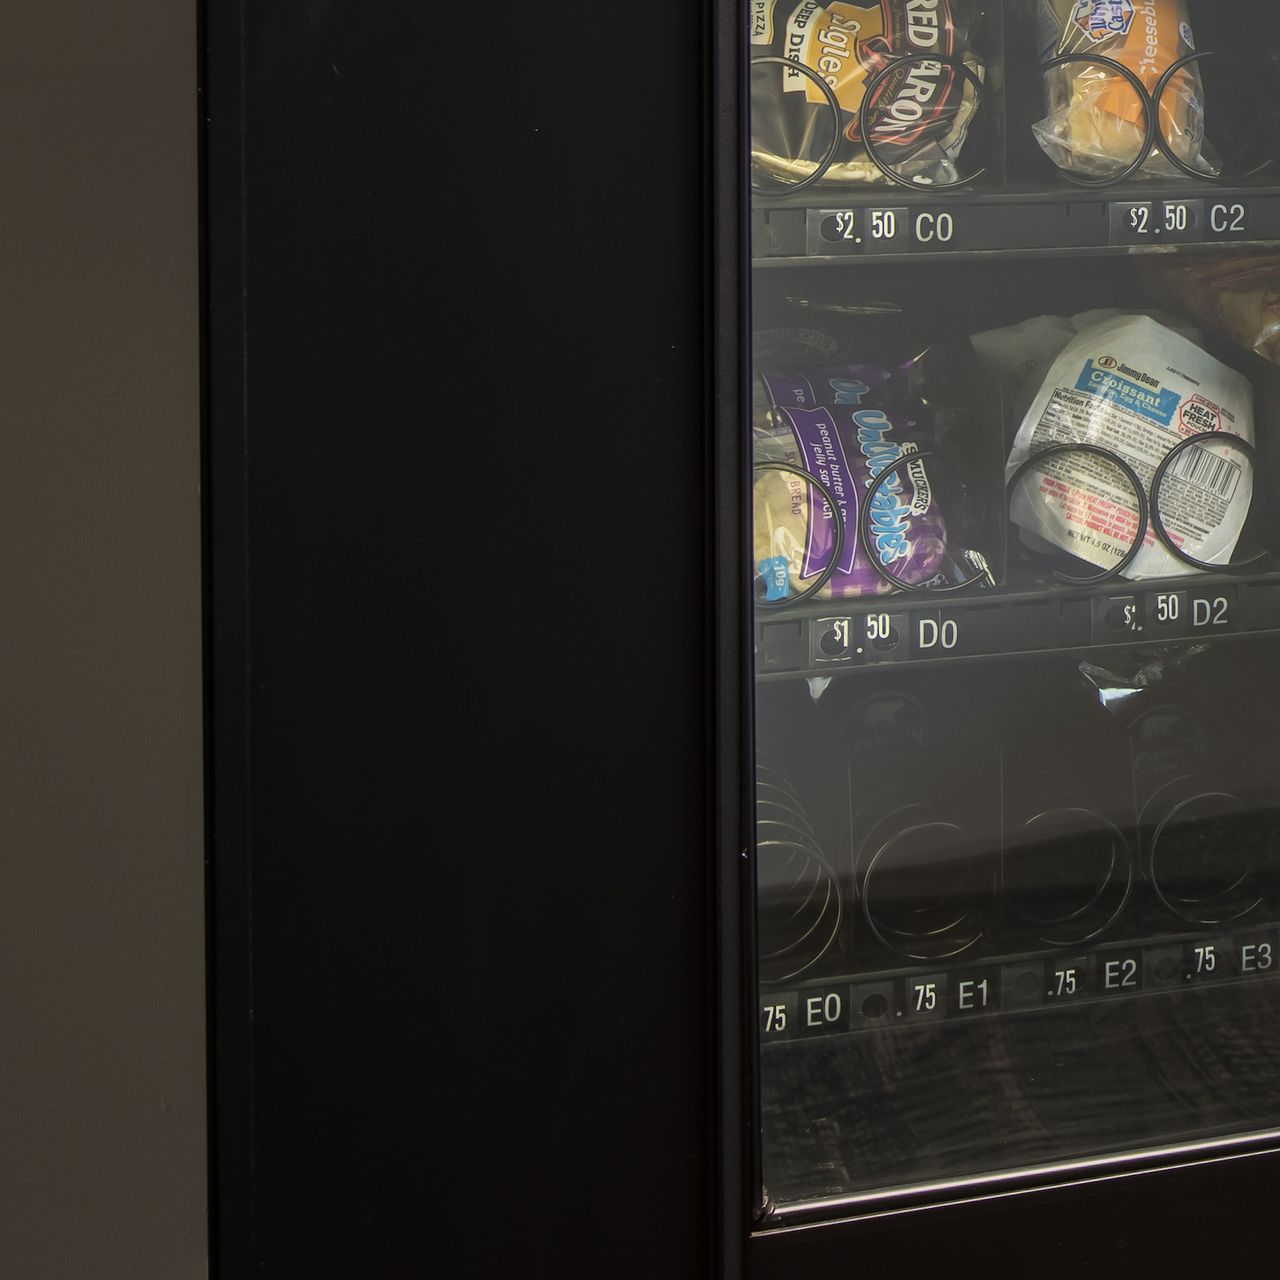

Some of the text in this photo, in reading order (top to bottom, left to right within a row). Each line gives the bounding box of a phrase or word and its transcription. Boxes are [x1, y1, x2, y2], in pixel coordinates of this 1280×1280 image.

[1130, 205, 1245, 234] $2.50 C2
[1182, 410, 1216, 432] FRESH
[1189, 403, 1217, 421] HEAT
